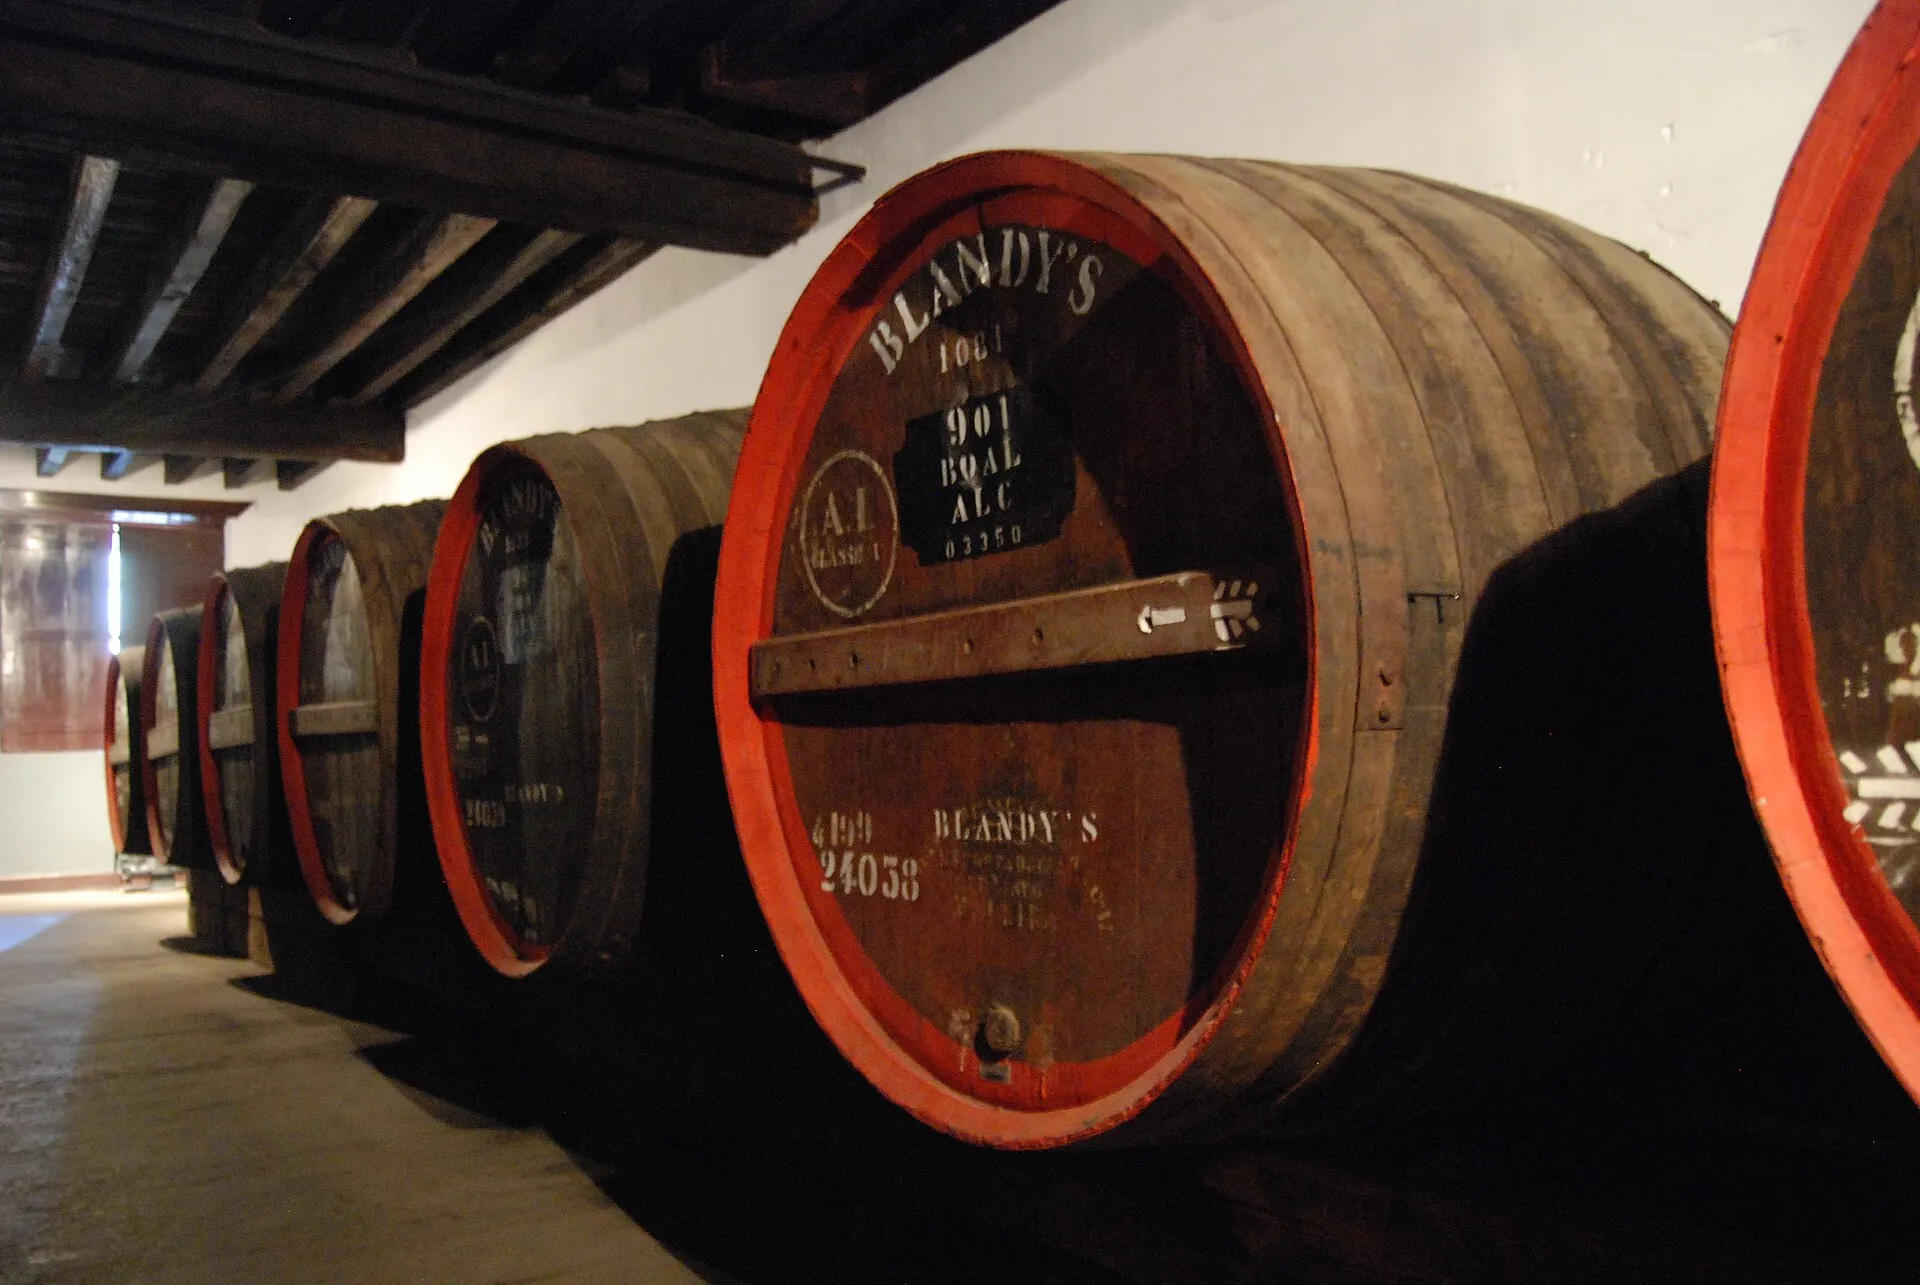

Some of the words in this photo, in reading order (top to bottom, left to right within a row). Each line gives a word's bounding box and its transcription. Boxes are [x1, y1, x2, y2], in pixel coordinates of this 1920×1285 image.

[868, 227, 1104, 375] BLANDY'S
[946, 396, 1011, 447] 901
[940, 437, 1021, 488] BOAL
[951, 481, 1013, 524] ALC
[944, 524, 1022, 559] 03350
[933, 808, 1100, 844] BLANDY'S
